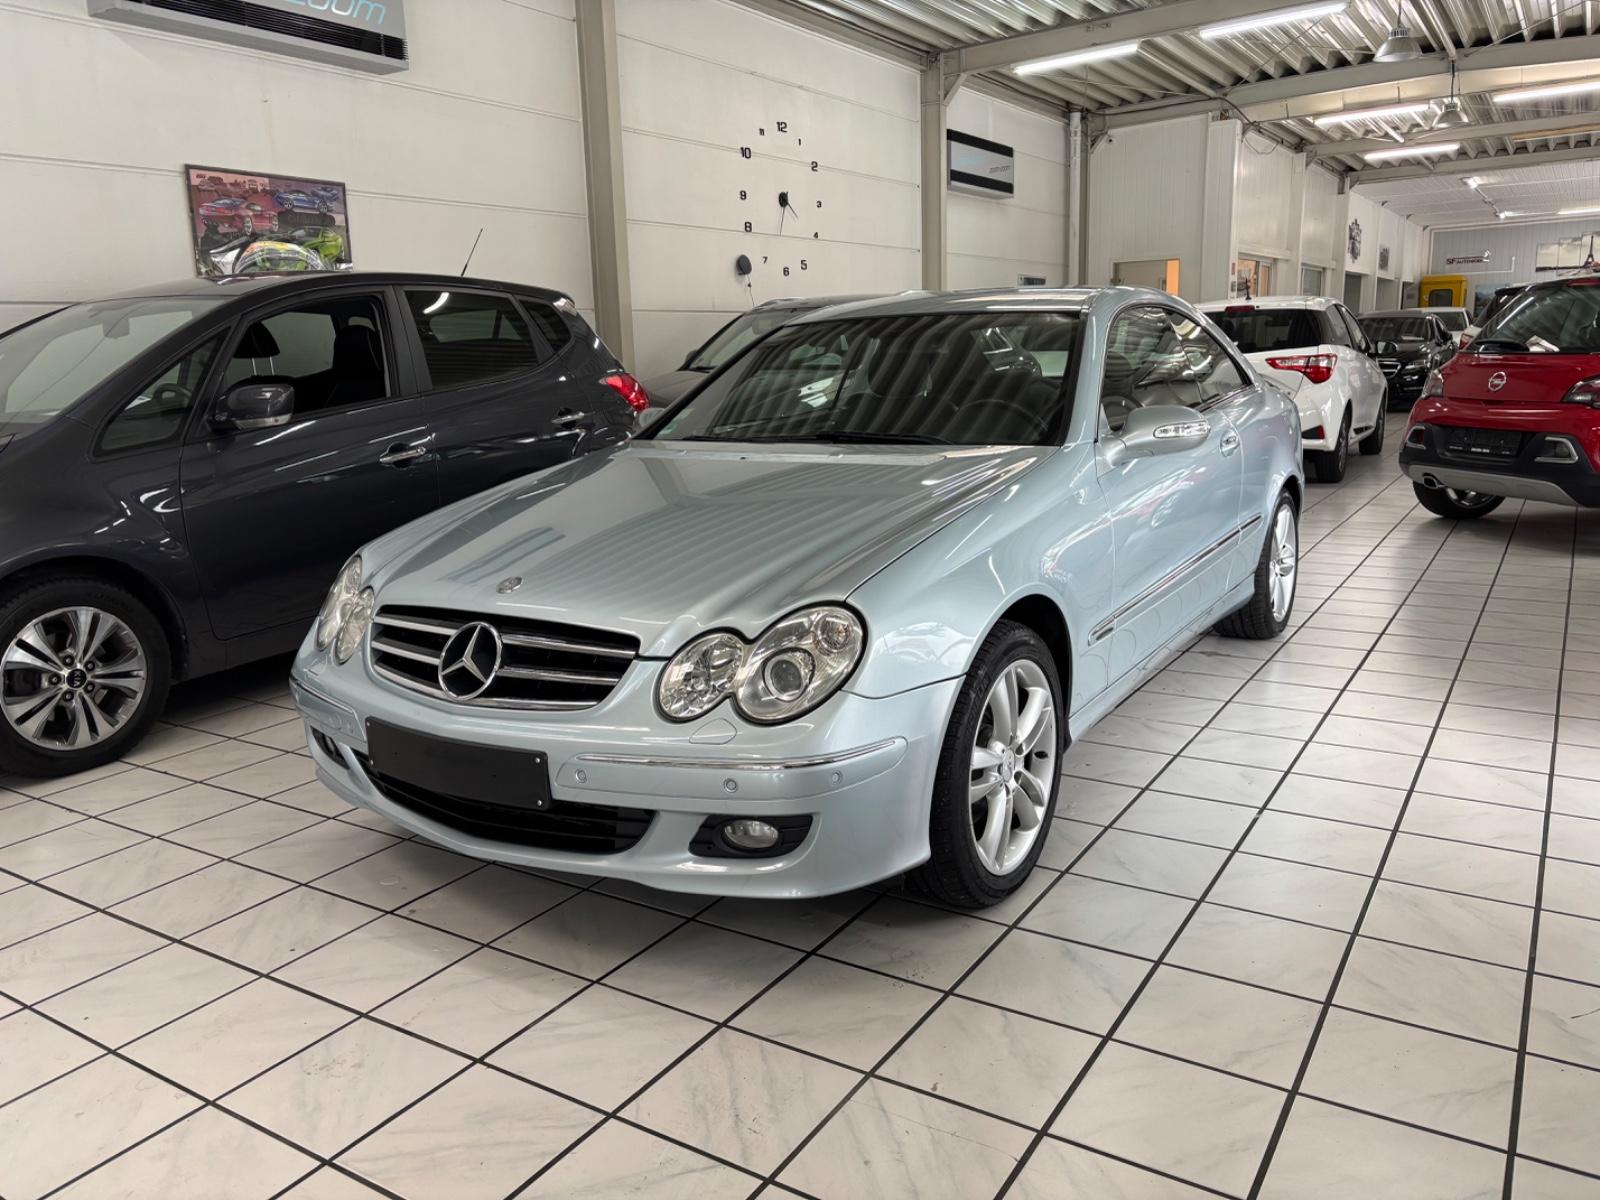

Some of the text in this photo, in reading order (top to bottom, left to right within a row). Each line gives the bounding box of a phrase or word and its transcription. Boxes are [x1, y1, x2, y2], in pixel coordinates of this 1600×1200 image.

[776, 121, 788, 133] 12
[798, 138, 802, 146] 1
[740, 147, 752, 159] 10
[810, 161, 818, 172] 2
[739, 190, 747, 200] 9
[816, 200, 822, 208] 3
[744, 221, 752, 233] 8
[813, 231, 819, 239] 4
[762, 256, 768, 264] 7
[800, 259, 808, 270] 5
[782, 267, 790, 276] 6
